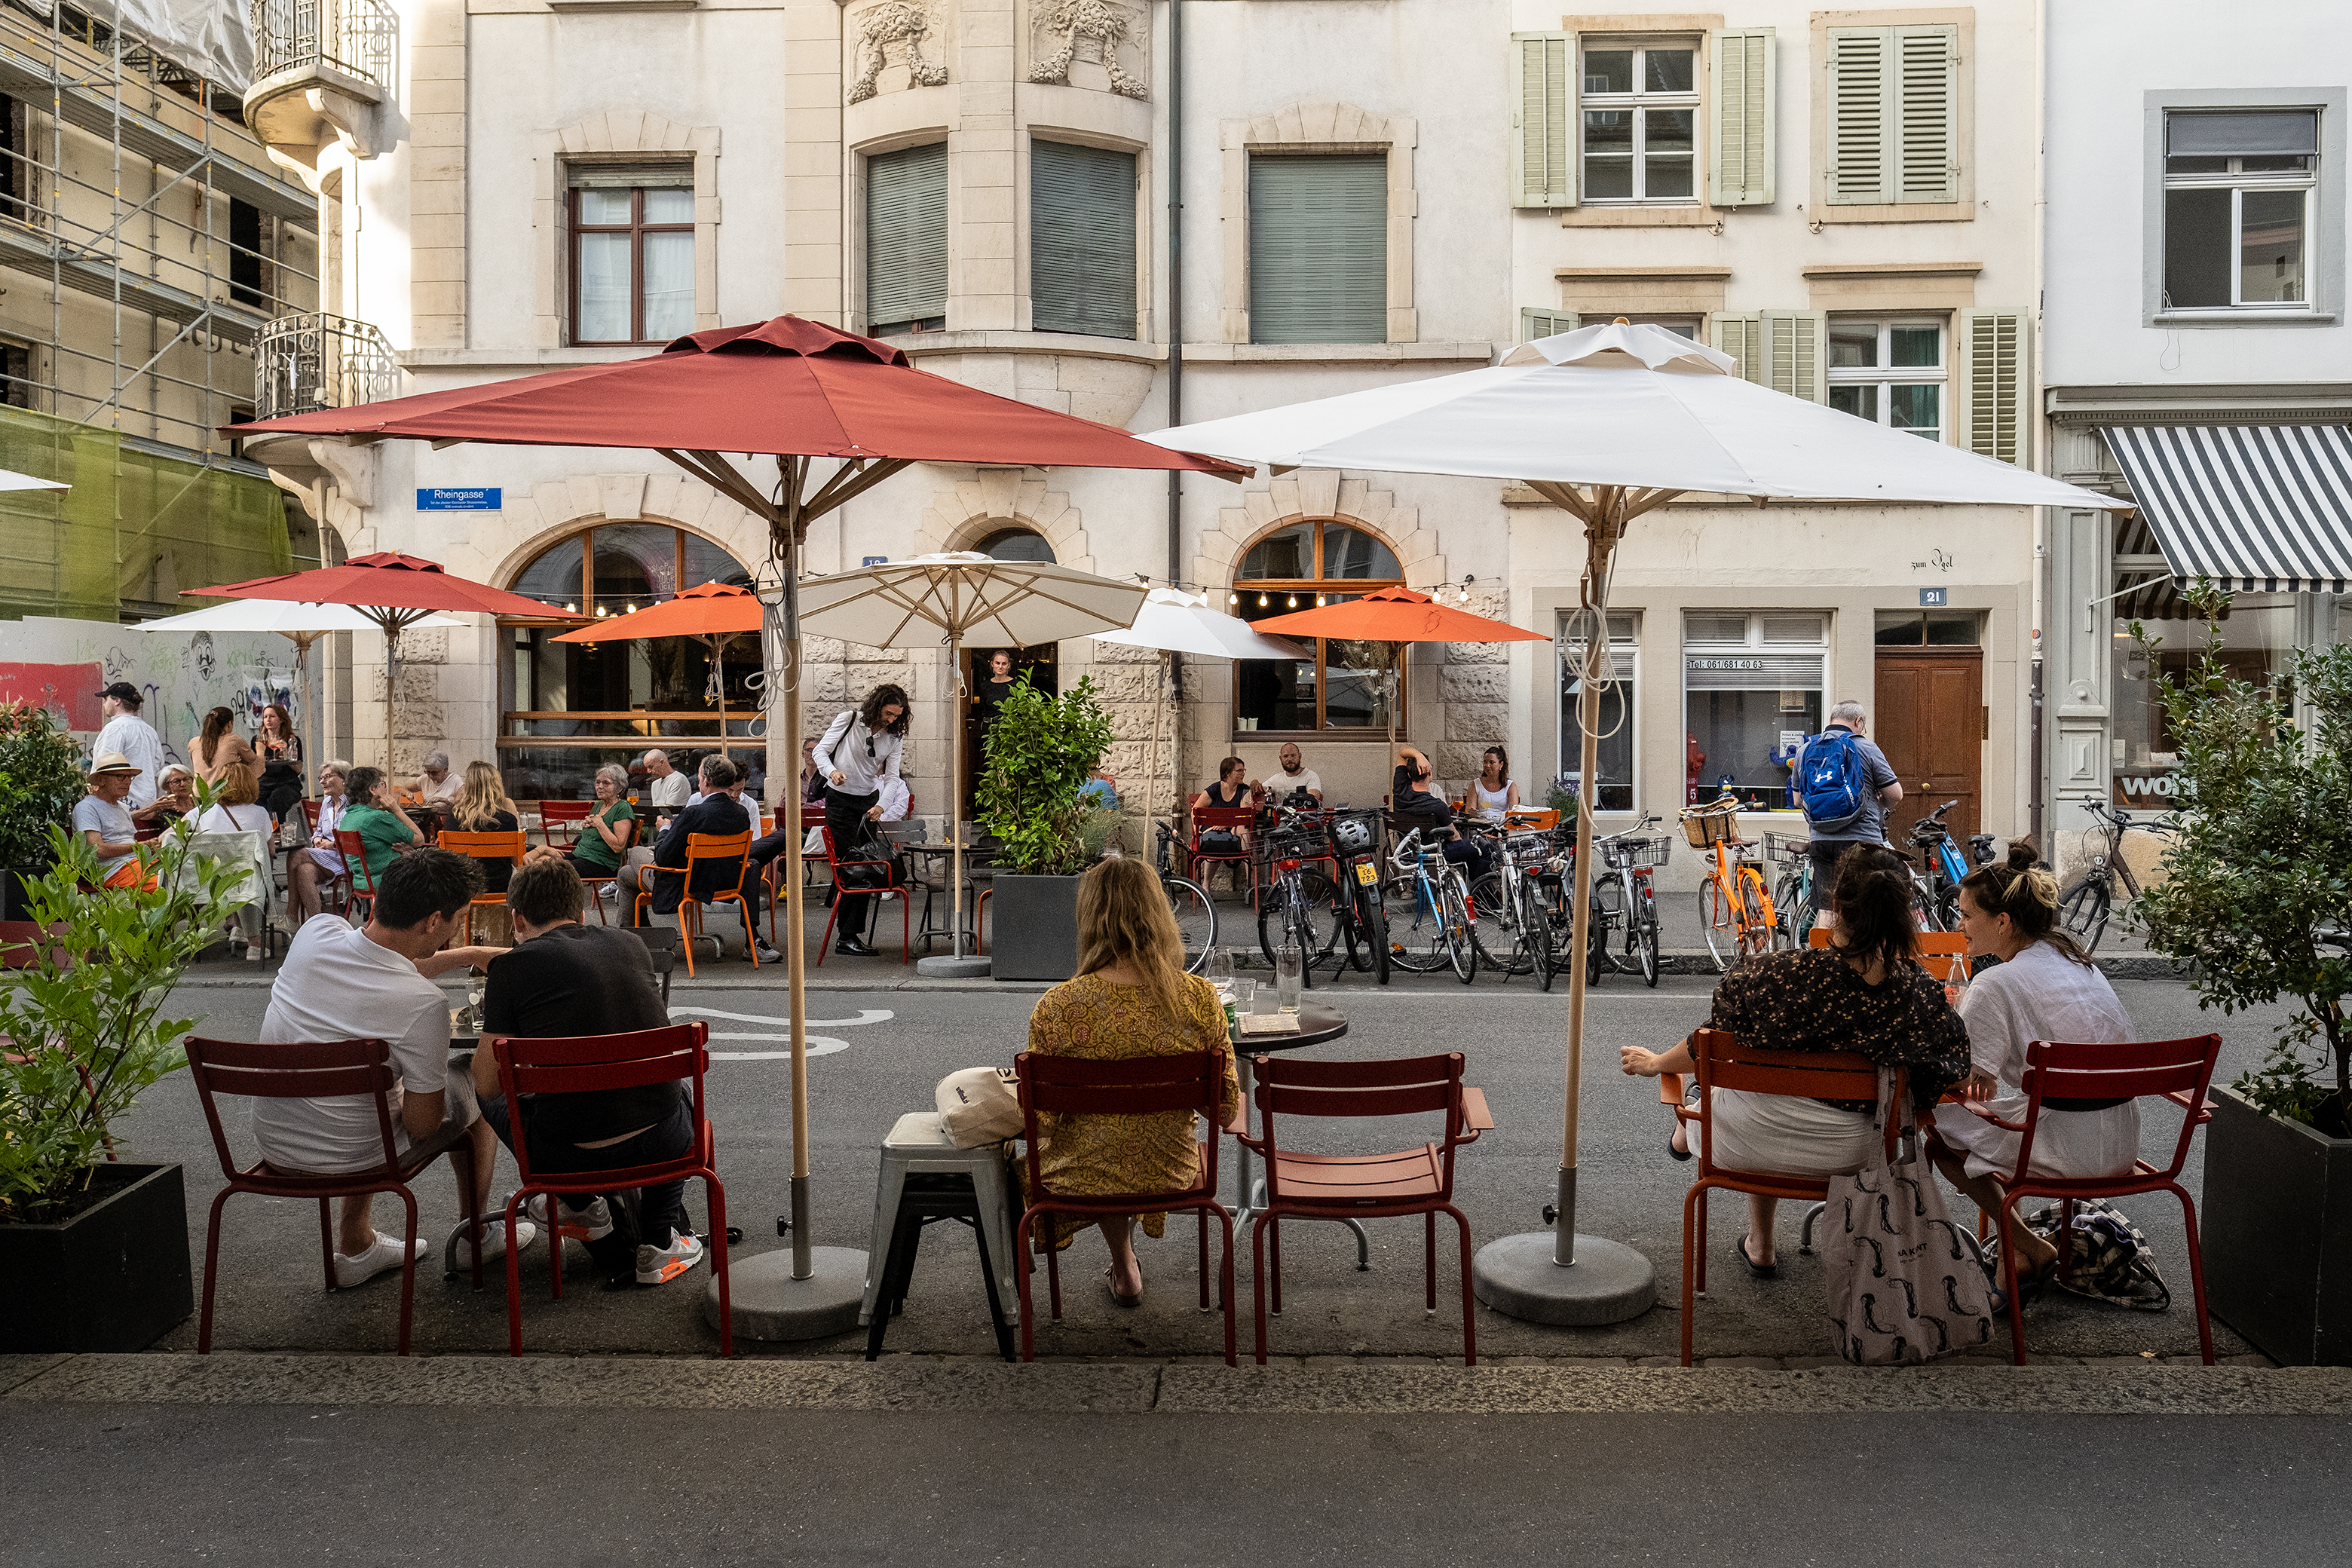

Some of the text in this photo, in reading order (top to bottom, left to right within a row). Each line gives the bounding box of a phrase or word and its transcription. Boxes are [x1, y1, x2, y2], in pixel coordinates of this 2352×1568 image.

[434, 489, 484, 501] Rheingasse
[651, 562, 675, 574] SUPPOR
[1911, 562, 1927, 571] zum
[1927, 591, 1940, 602] 21
[1690, 660, 1762, 669] Tel: 061/681 40 63
[1689, 788, 1696, 800] 5
[2126, 871, 2140, 897] FISCHE
